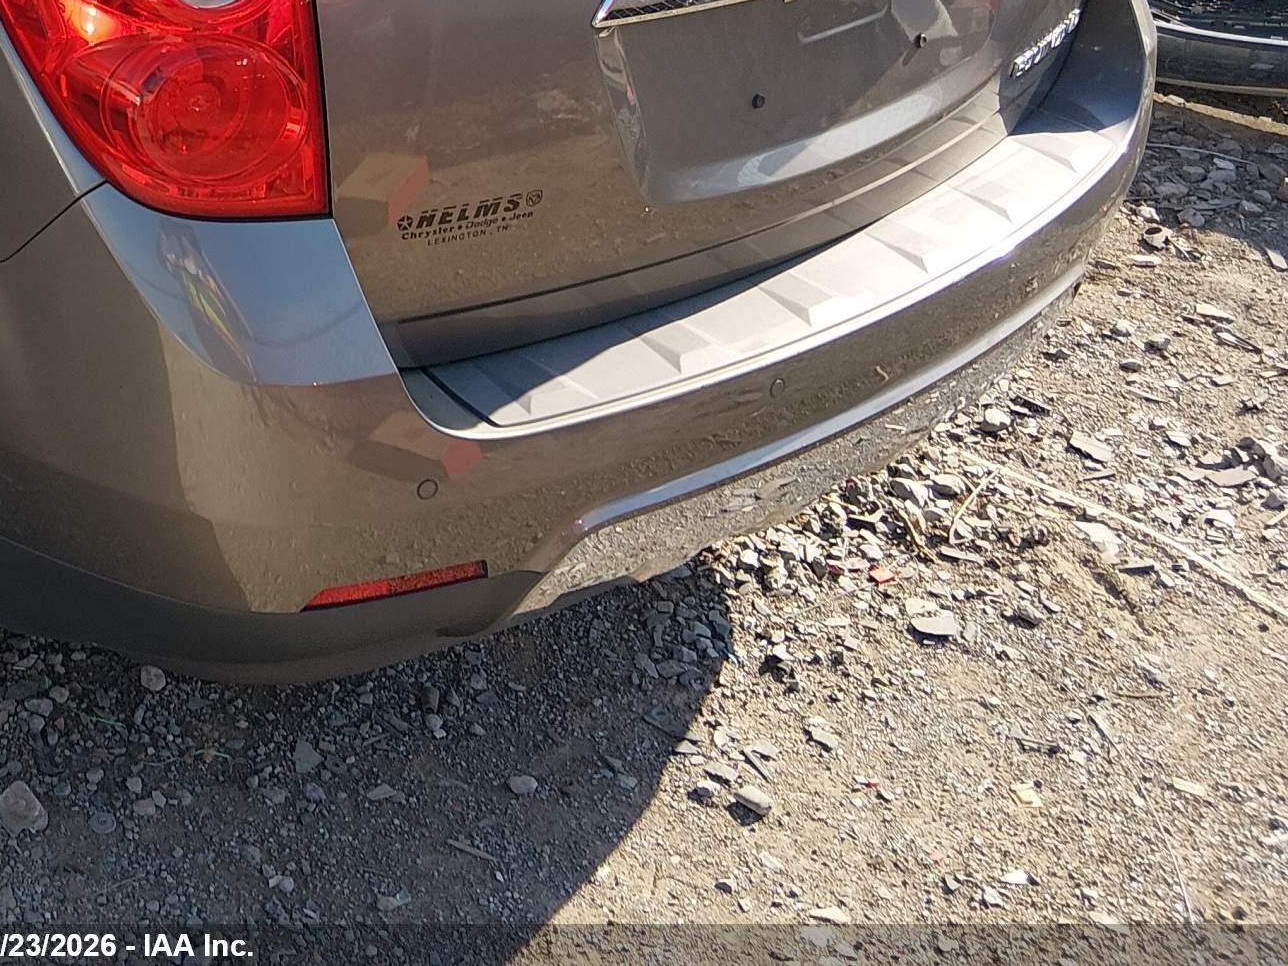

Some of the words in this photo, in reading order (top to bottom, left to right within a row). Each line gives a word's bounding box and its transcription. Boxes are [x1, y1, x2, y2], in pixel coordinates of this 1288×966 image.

[401, 225, 455, 240] Chrysler
[465, 217, 500, 230] Dodge
[510, 211, 534, 222] Jeep
[416, 193, 523, 229] HELMS
